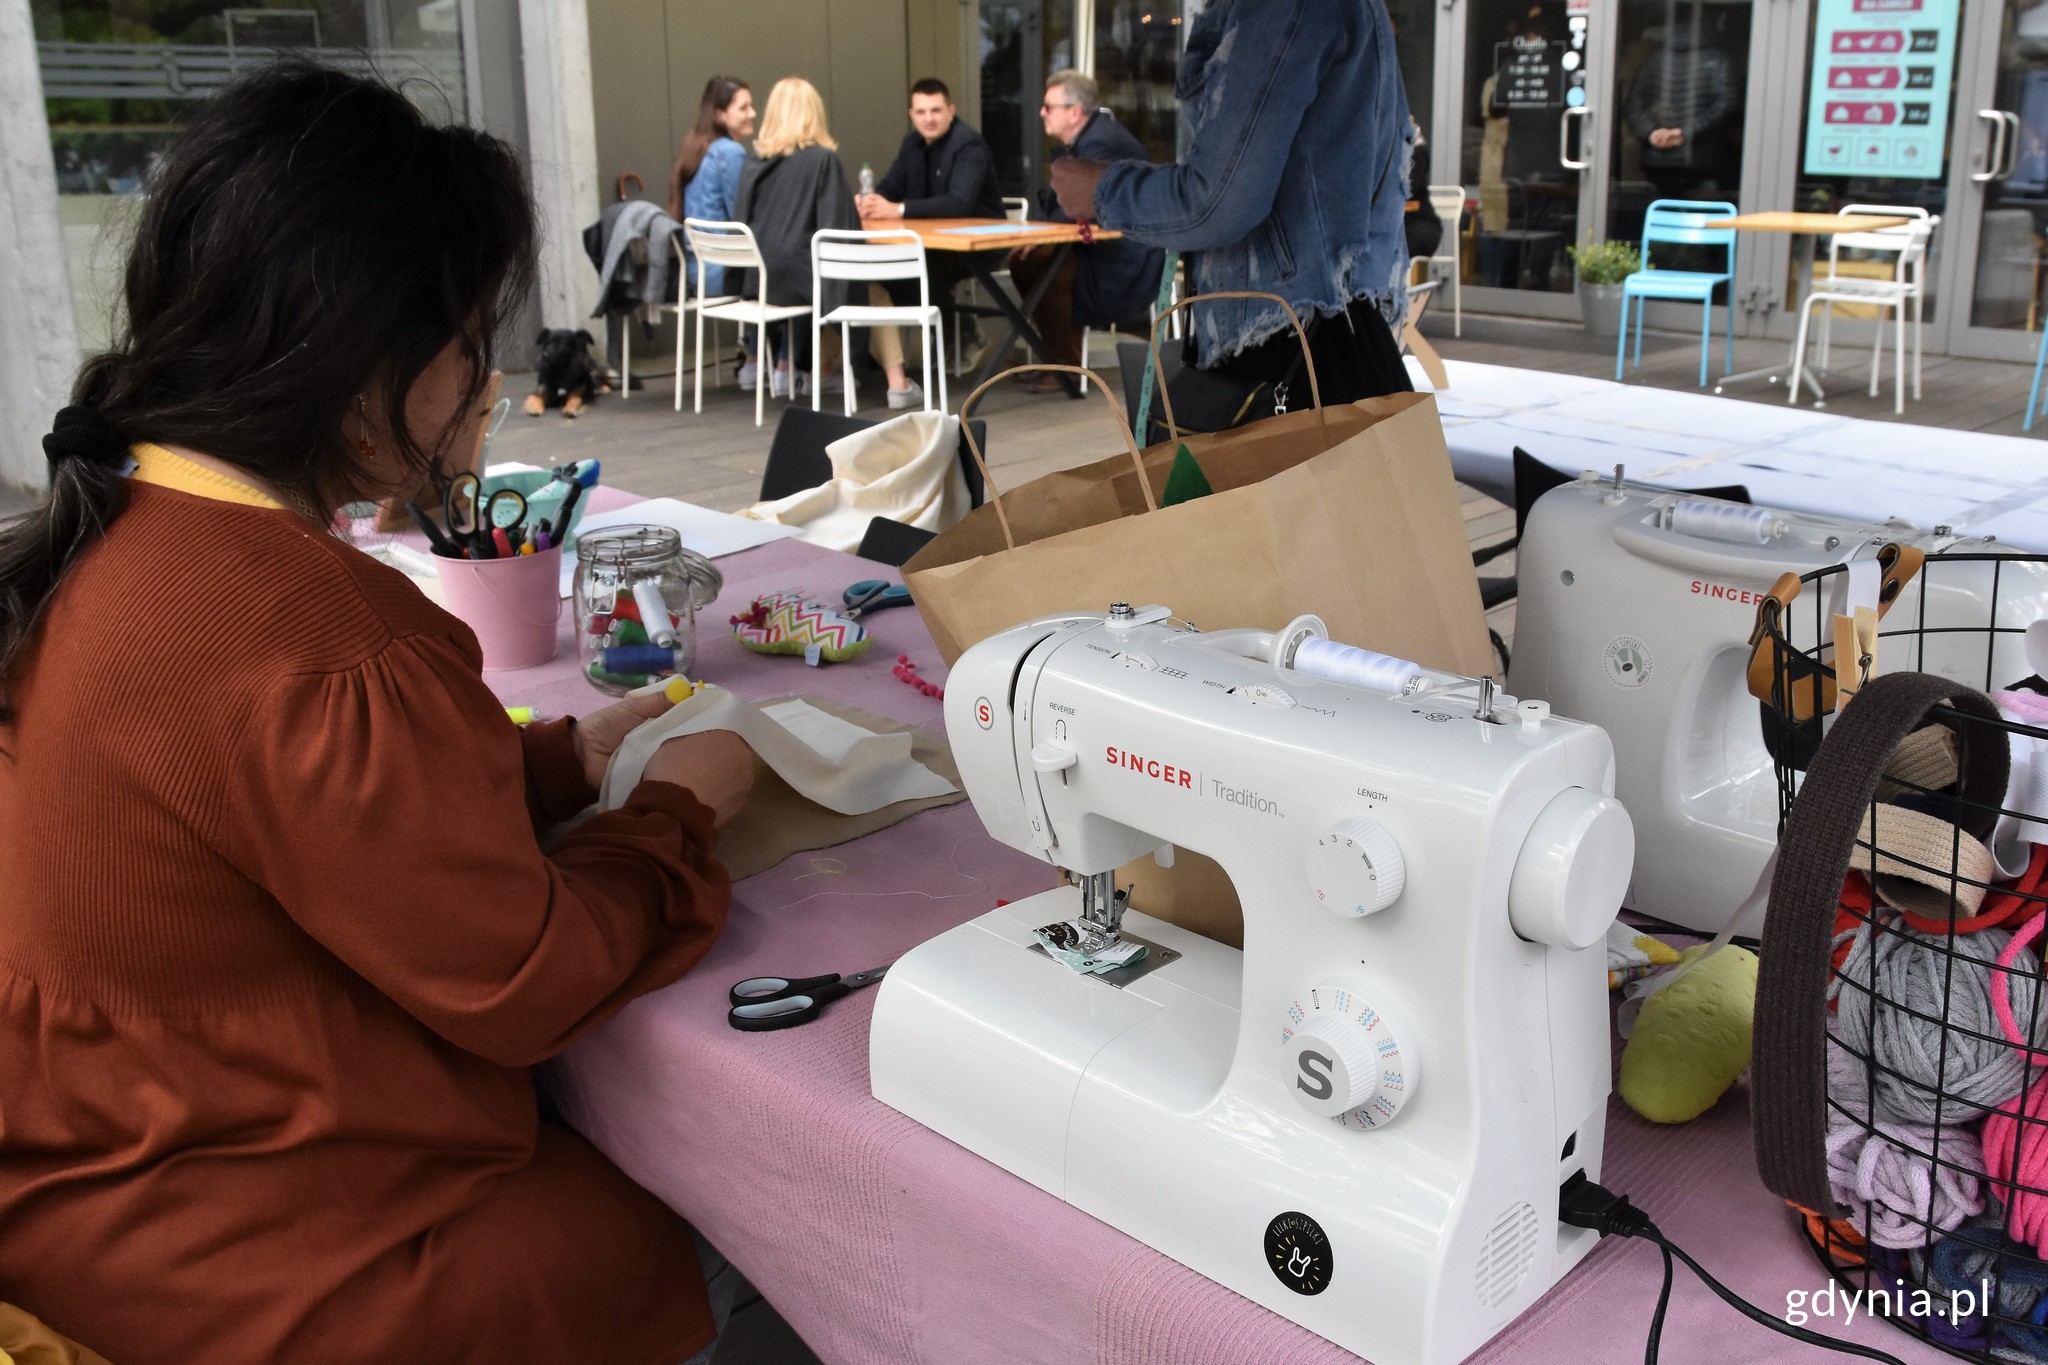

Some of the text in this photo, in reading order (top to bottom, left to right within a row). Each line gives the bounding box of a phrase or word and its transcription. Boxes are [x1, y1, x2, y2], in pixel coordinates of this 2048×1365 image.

[1691, 581, 1764, 605] SINGER
[1086, 643, 1111, 654] TENSION
[1202, 679, 1226, 689] WIDTH
[979, 704, 990, 722] S
[1049, 702, 1076, 716] REVERSE
[1106, 746, 1192, 789] SINGER
[1211, 779, 1278, 816] Tradition
[1357, 787, 1388, 802] LENGTH
[1331, 834, 1338, 843] 3
[1346, 839, 1353, 847] 2
[1297, 1050, 1333, 1100] S
